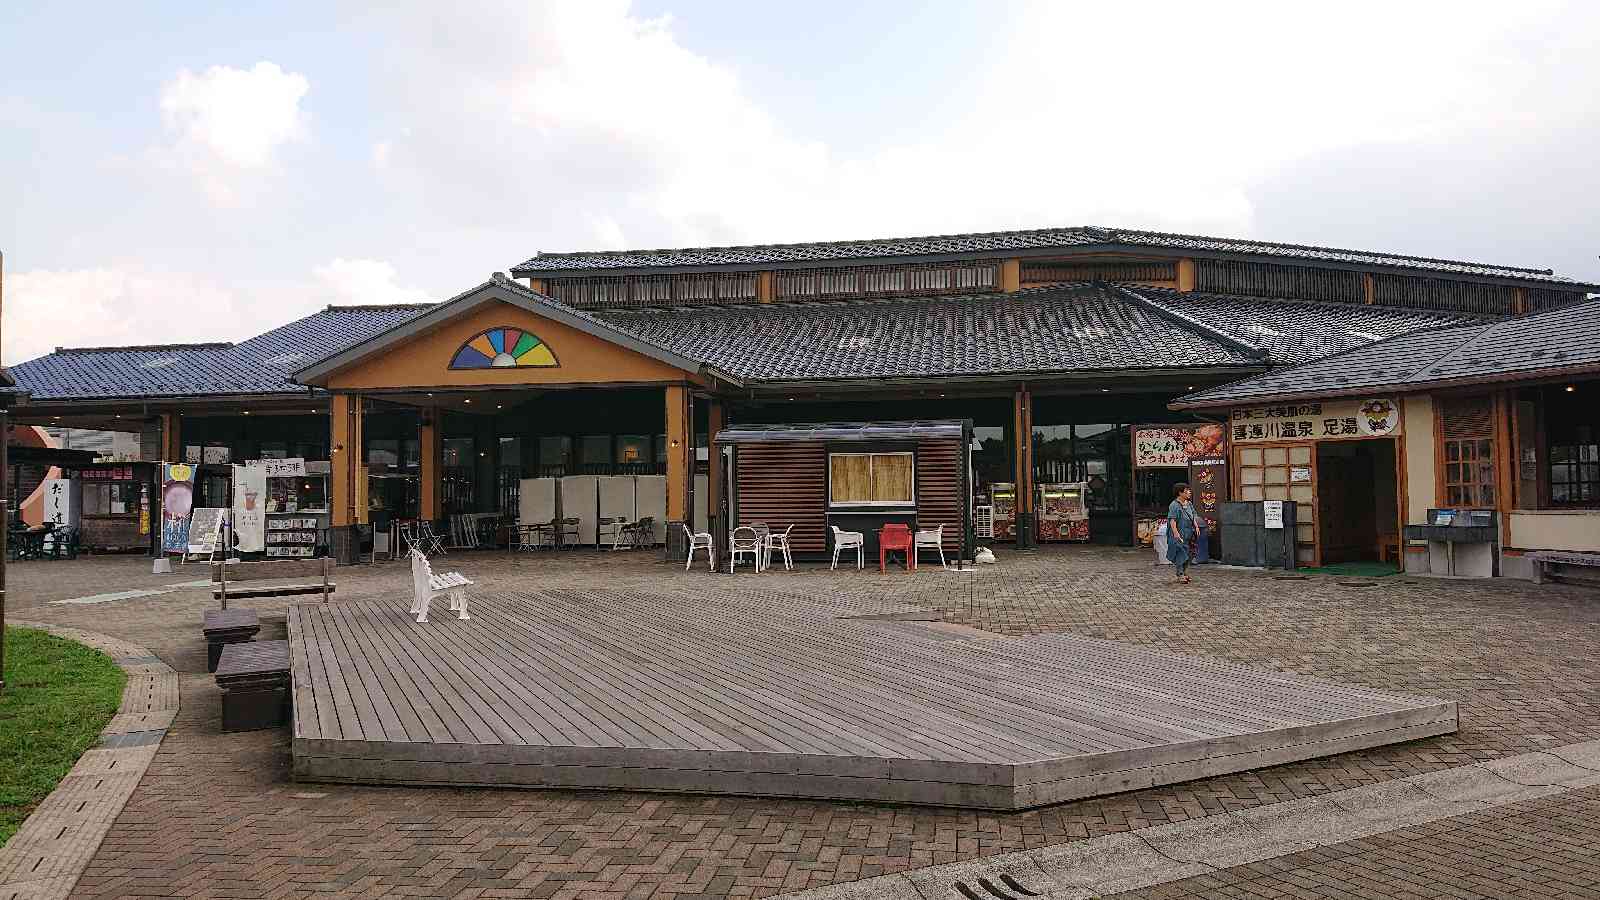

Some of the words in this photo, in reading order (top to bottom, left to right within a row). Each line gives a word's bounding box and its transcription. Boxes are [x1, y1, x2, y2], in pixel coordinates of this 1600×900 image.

[1233, 404, 1322, 420] 日本三大美肌の湯
[1233, 421, 1314, 440] 喜連川温泉
[1323, 418, 1357, 436] 足湯
[51, 483, 65, 534] だし道
